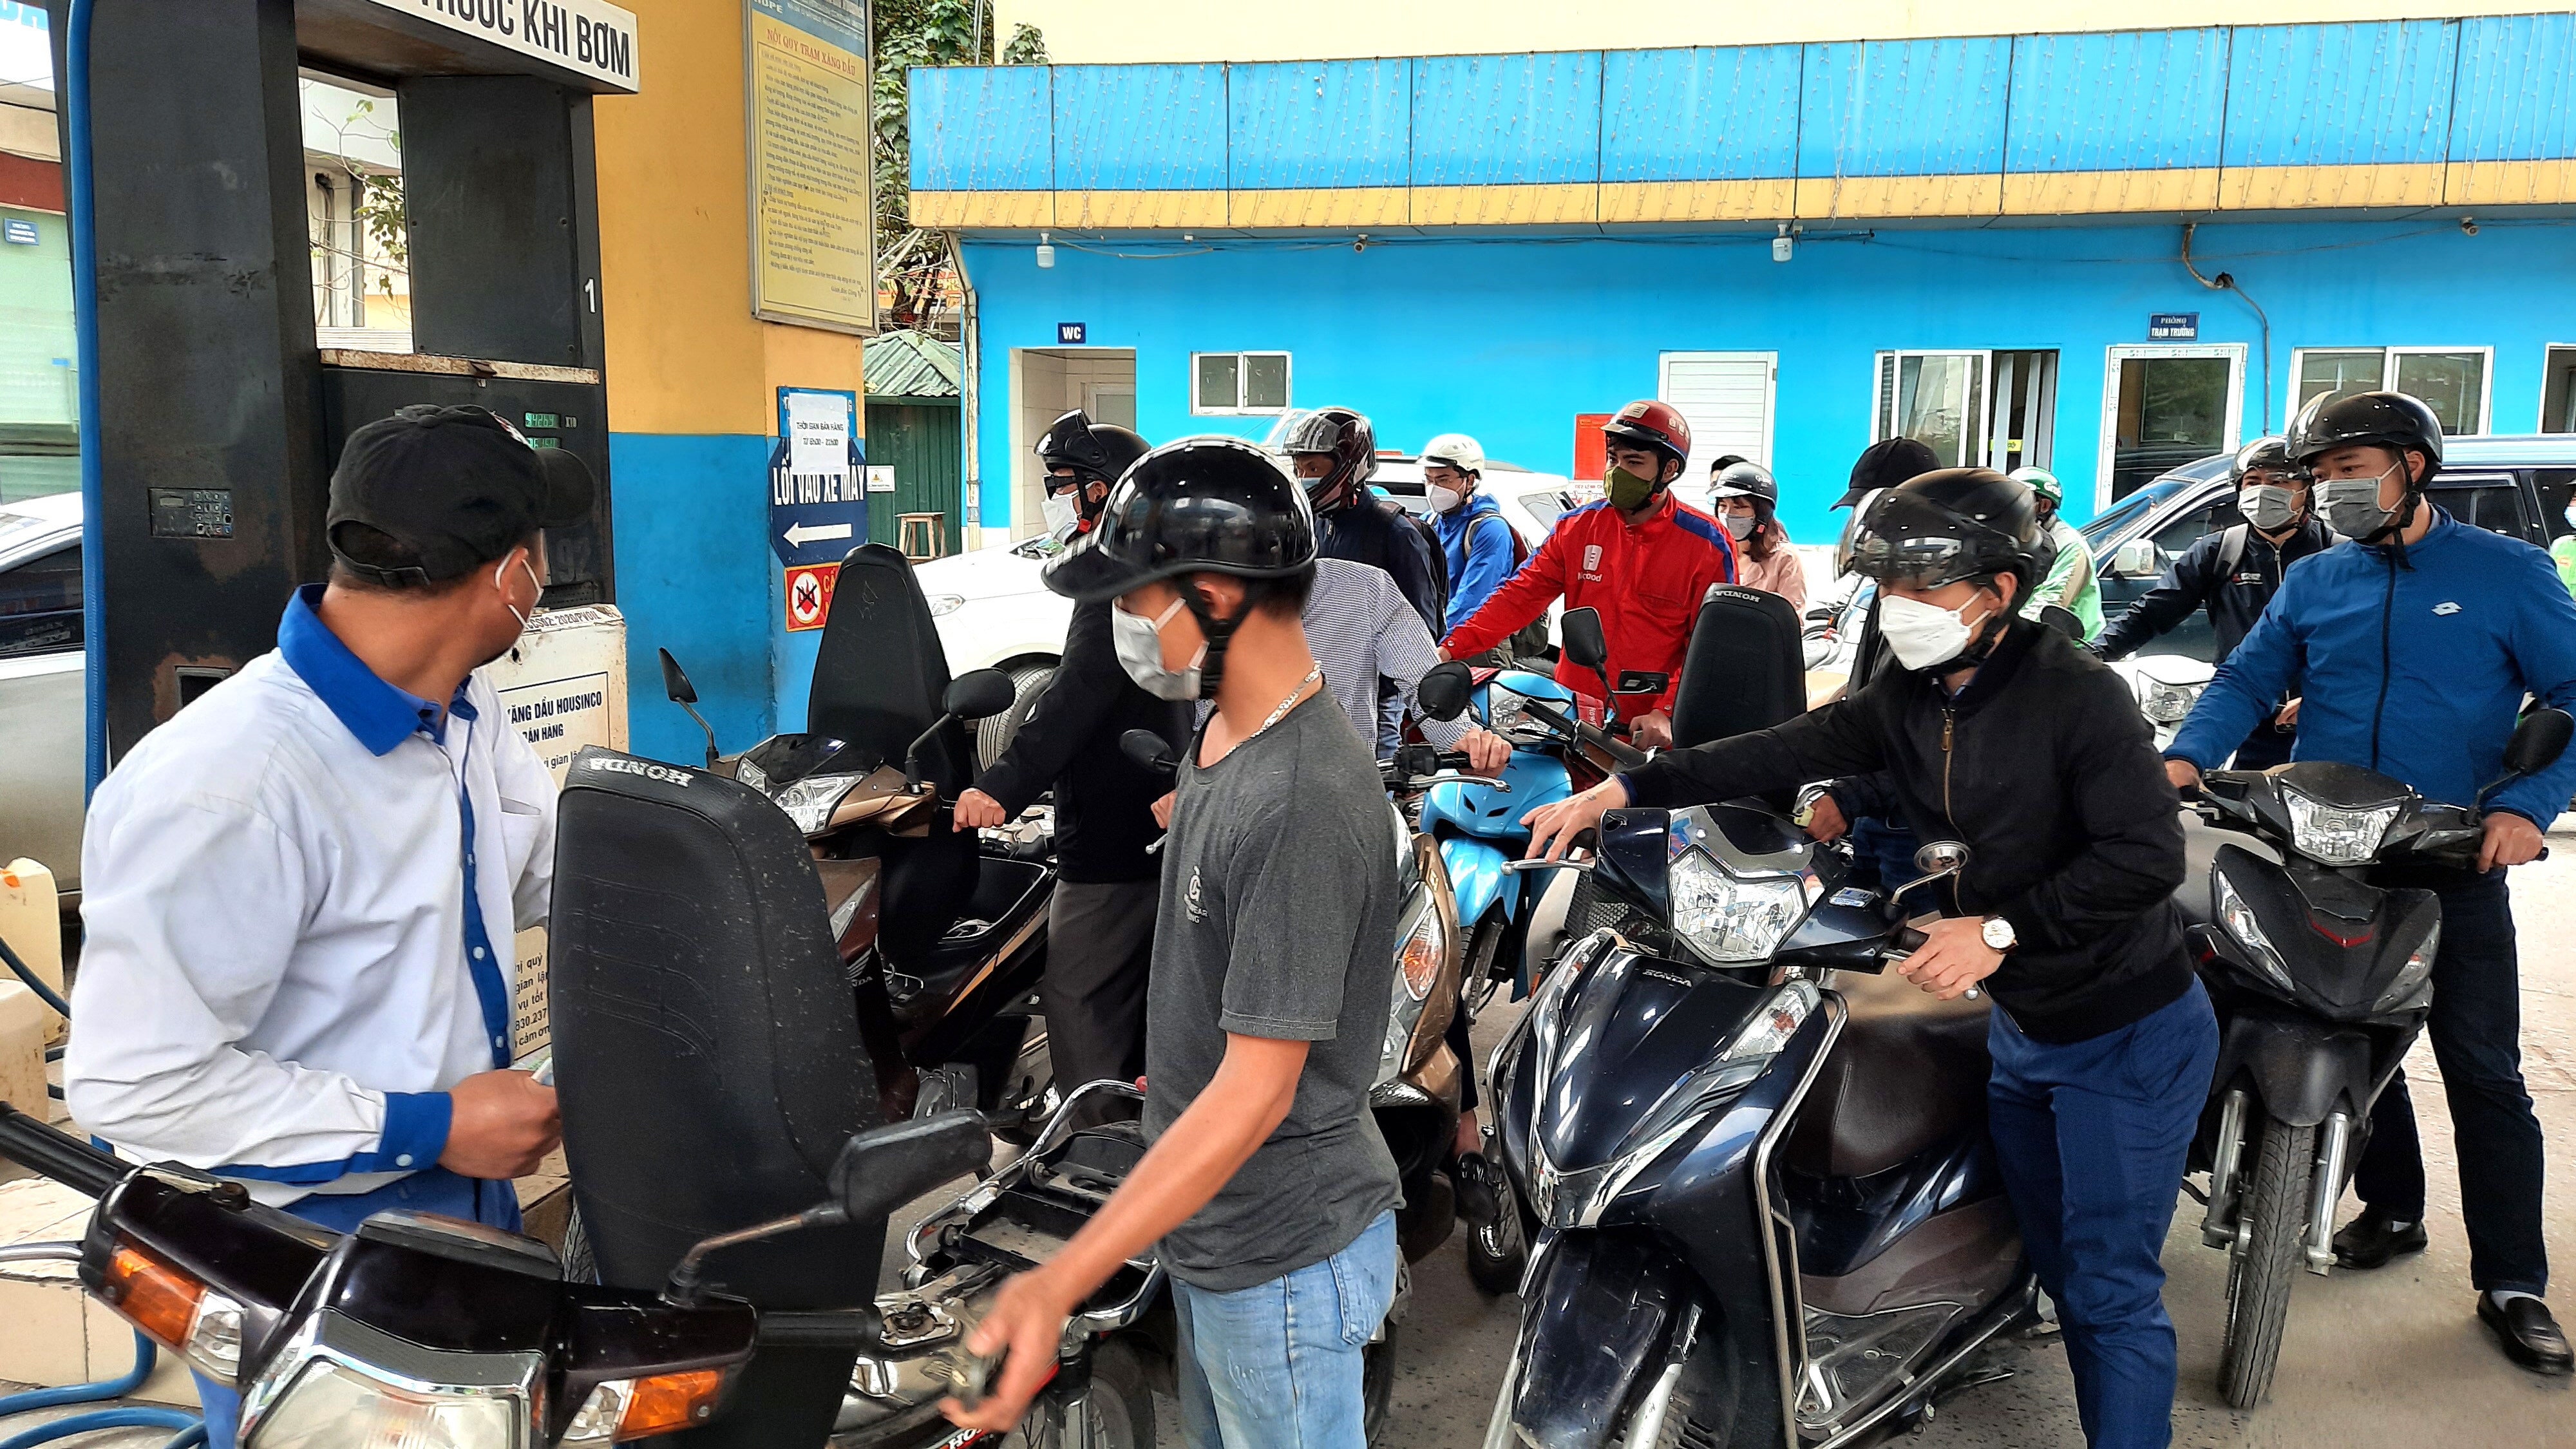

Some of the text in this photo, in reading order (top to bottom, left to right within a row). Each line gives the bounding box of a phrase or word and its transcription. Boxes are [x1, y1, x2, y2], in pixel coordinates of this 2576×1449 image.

[523, 0, 569, 56] KHI
[576, 14, 630, 78] BƠM
[783, 37, 799, 52] QUY
[800, 43, 820, 61] TRẠM
[585, 278, 596, 313] 1
[1063, 326, 1081, 339] WC
[2152, 327, 2169, 338] TRẠM
[773, 452, 795, 506] LỐI
[824, 474, 838, 502] XE
[840, 457, 865, 501] MÁY
[1714, 591, 1760, 603] HONDA
[507, 691, 602, 724] ĂNG DẦU HOUSINCO
[542, 723, 564, 741] HÀNG
[551, 755, 569, 769] gian
[518, 998, 529, 1010] vụ
